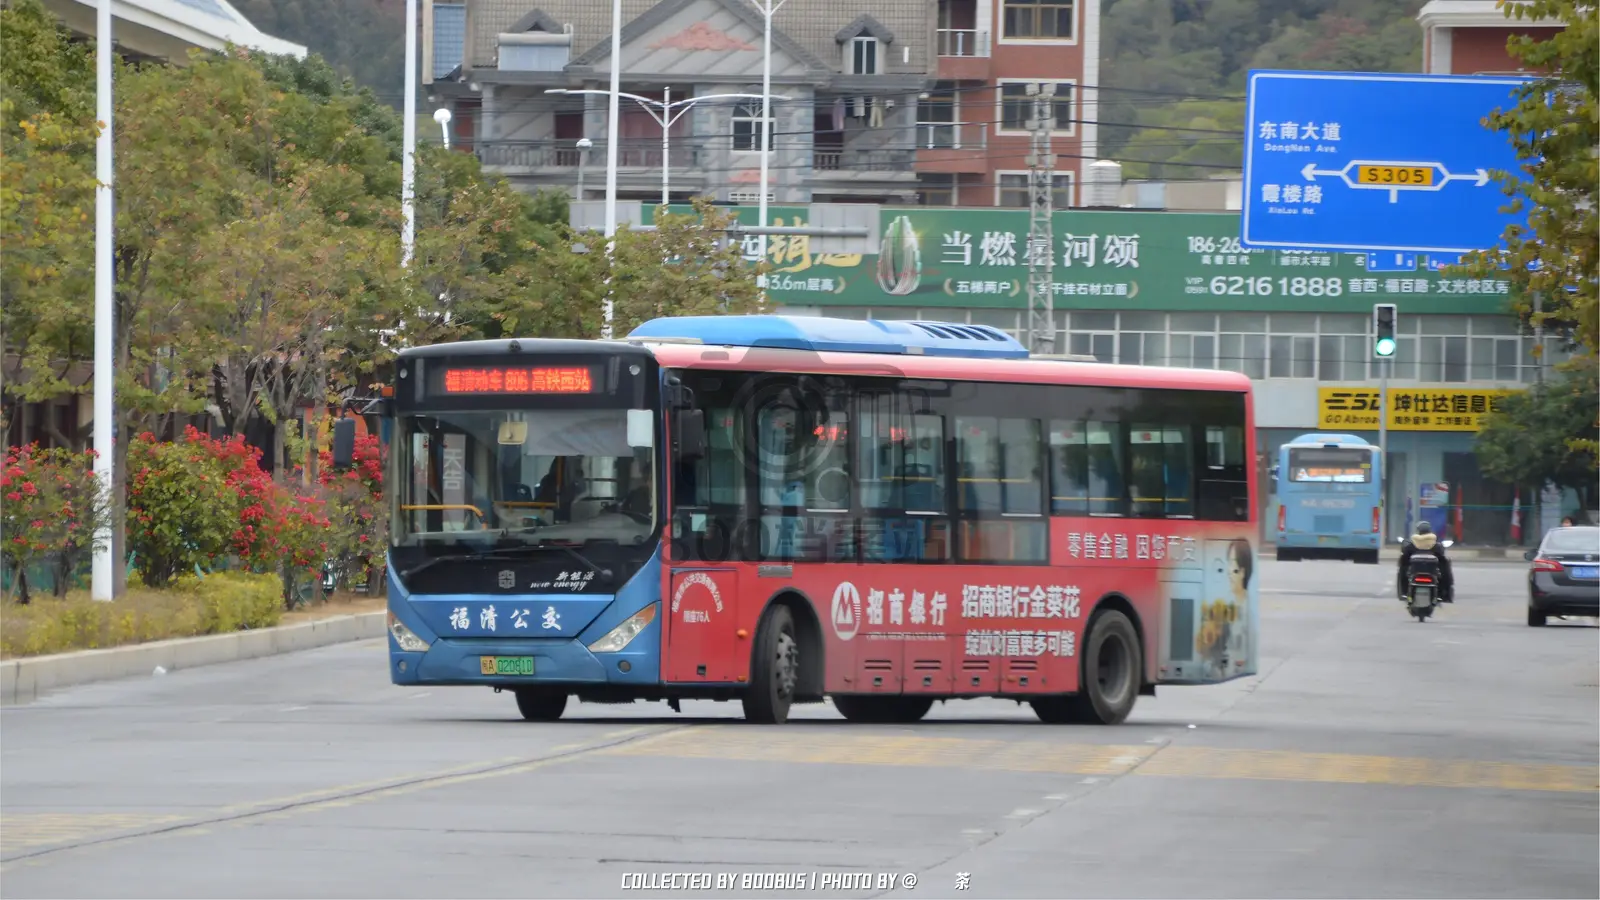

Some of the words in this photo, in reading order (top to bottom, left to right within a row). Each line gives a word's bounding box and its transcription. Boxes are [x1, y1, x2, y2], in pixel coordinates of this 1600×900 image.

[1258, 121, 1341, 141] 东南大道
[1368, 168, 1424, 183] S305
[1261, 184, 1323, 204] 霞楼路
[940, 231, 1140, 268] 当燃星河颂
[956, 281, 1011, 294] 五梯两户
[1210, 276, 1273, 296] 6216
[1279, 277, 1342, 297] 1888
[446, 369, 503, 392] 福清动车
[531, 368, 592, 393] 高铁西站
[1344, 415, 1381, 424] Abroa
[1067, 532, 1128, 559] 零售金融
[1136, 534, 1196, 561] 因您而变
[553, 580, 587, 591] energy
[556, 571, 595, 581] 新能源
[866, 588, 947, 625] 招商银行
[962, 584, 1080, 618] 招商银行金葵花
[450, 605, 561, 631] 福清公交
[965, 629, 1075, 656] 绽放财富更多可能
